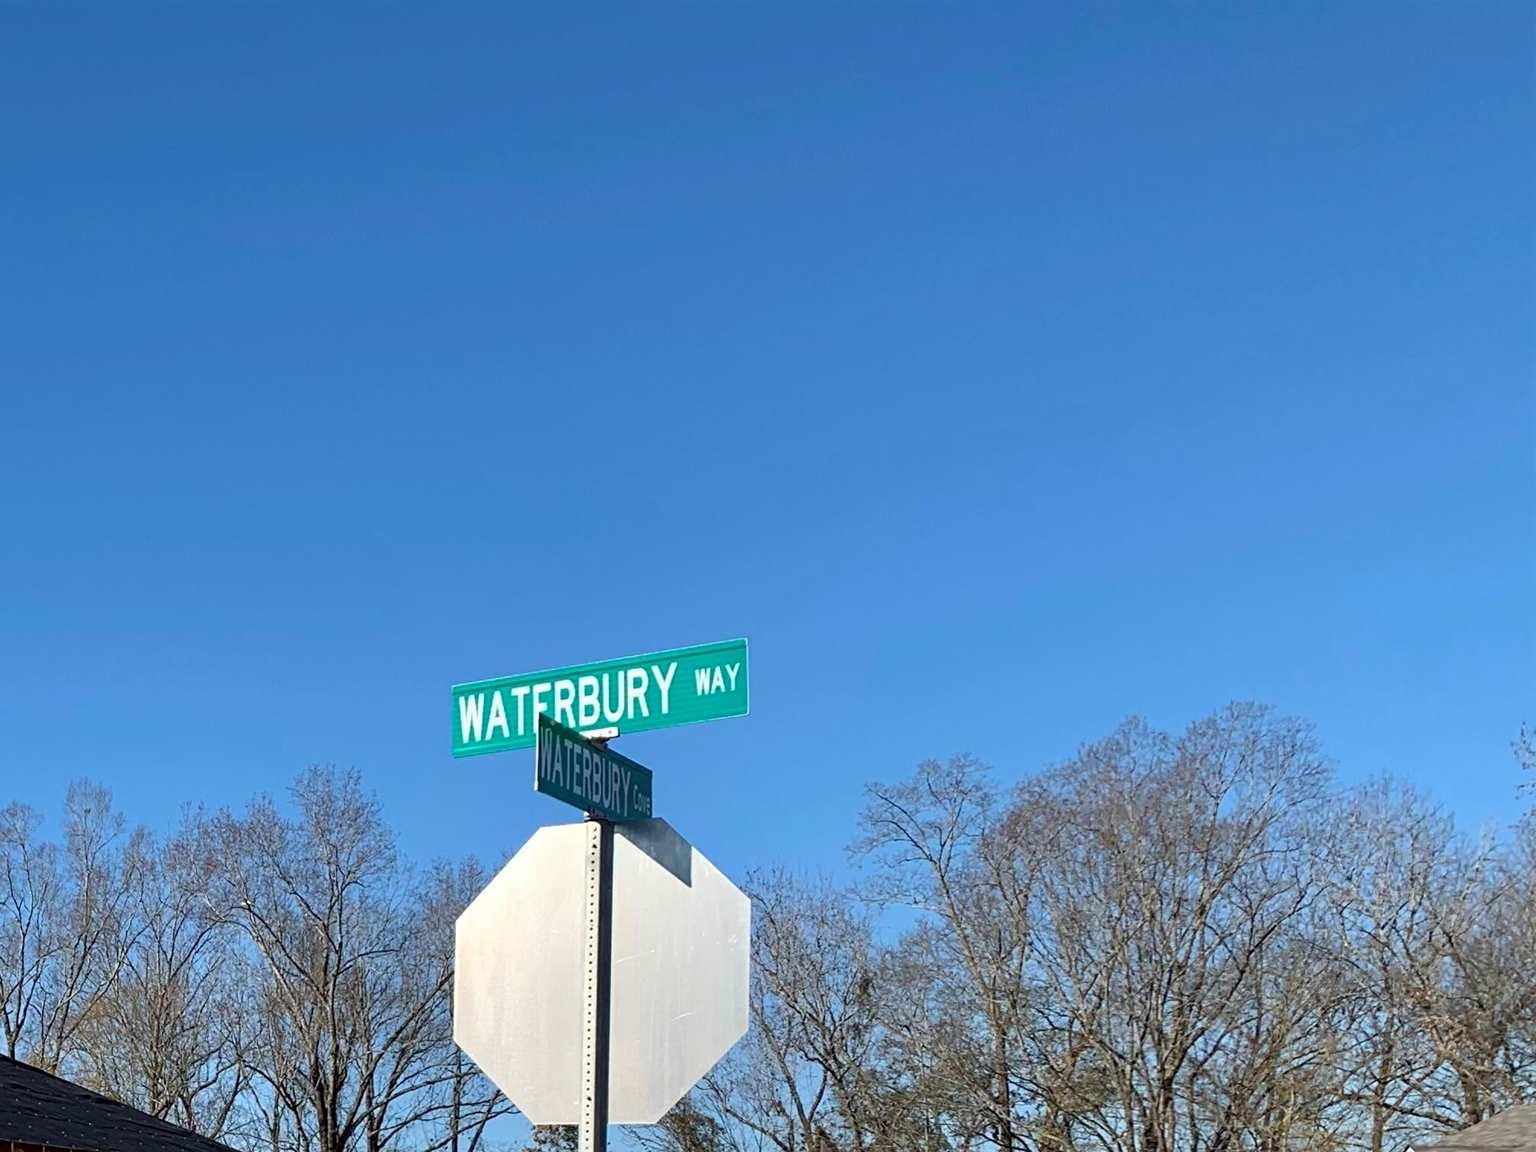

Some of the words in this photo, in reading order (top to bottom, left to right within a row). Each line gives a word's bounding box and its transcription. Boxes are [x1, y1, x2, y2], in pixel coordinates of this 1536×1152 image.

[459, 662, 677, 743] WATERBURY
[695, 663, 740, 696] WAY
[540, 726, 631, 817] WATERBURY
